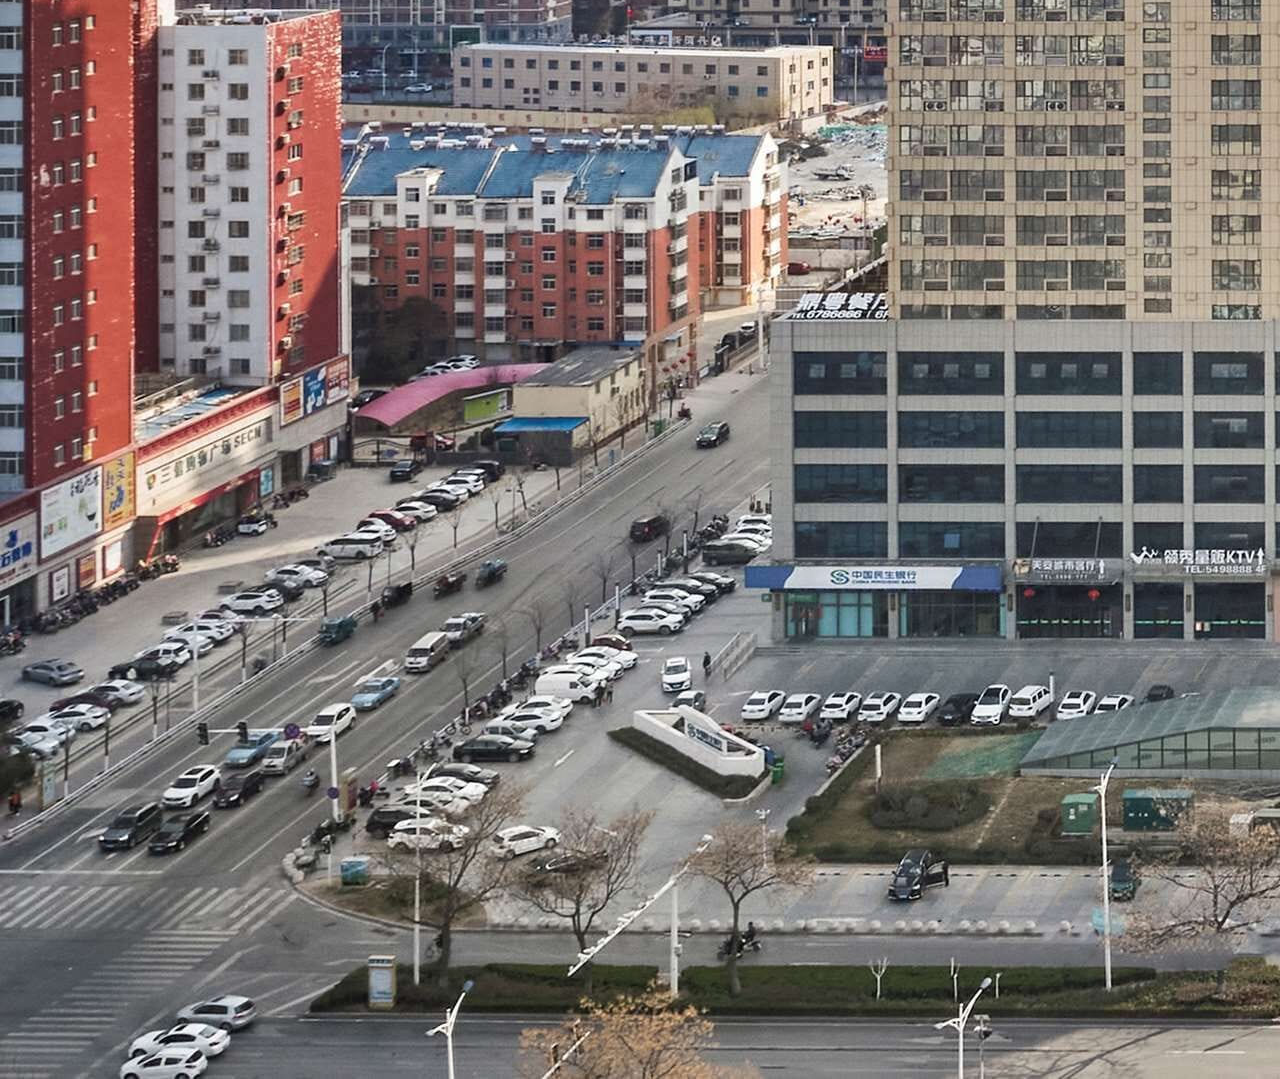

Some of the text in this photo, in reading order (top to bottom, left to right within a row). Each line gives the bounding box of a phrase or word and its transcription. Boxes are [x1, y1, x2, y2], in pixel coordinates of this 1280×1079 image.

[851, 570, 917, 579] 中国民生银行
